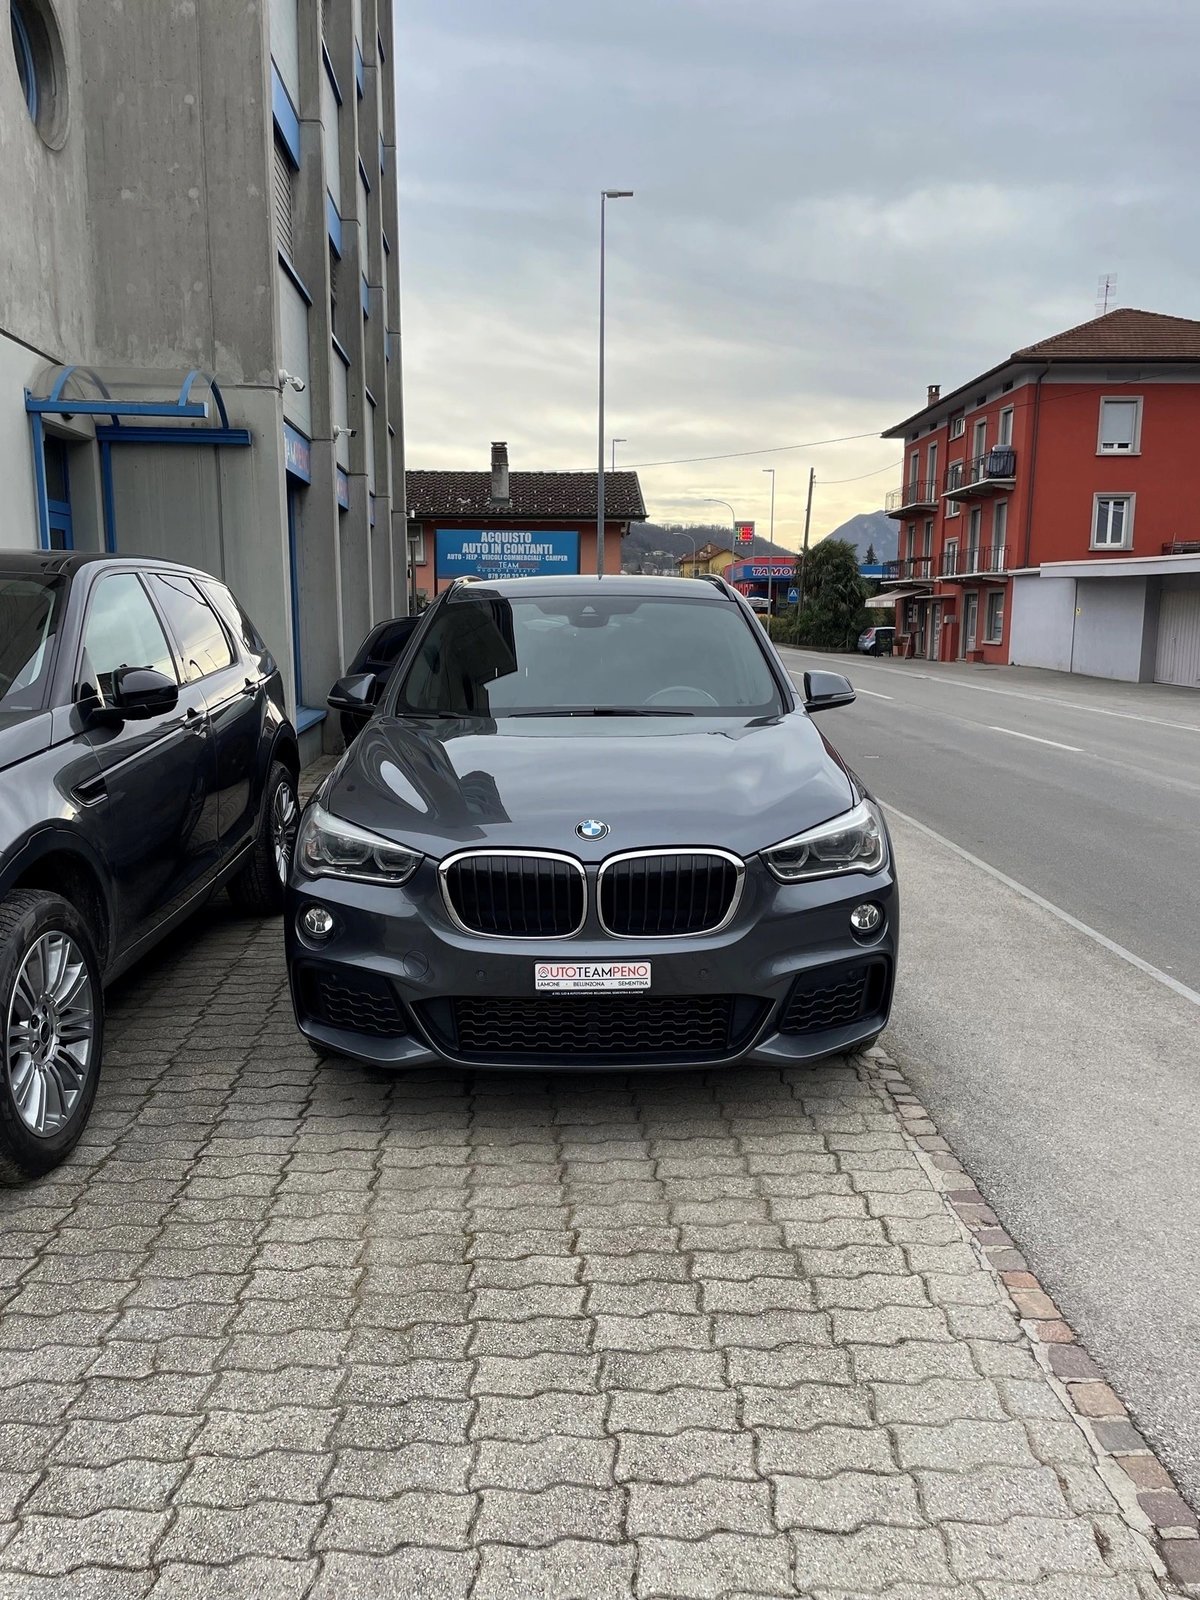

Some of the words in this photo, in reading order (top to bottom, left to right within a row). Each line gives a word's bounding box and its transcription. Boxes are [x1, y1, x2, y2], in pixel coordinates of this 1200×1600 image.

[481, 532, 532, 543] ACQUISTO
[462, 543, 490, 554] AUTO
[491, 544, 501, 554] IN
[503, 544, 553, 555] CONTANTI
